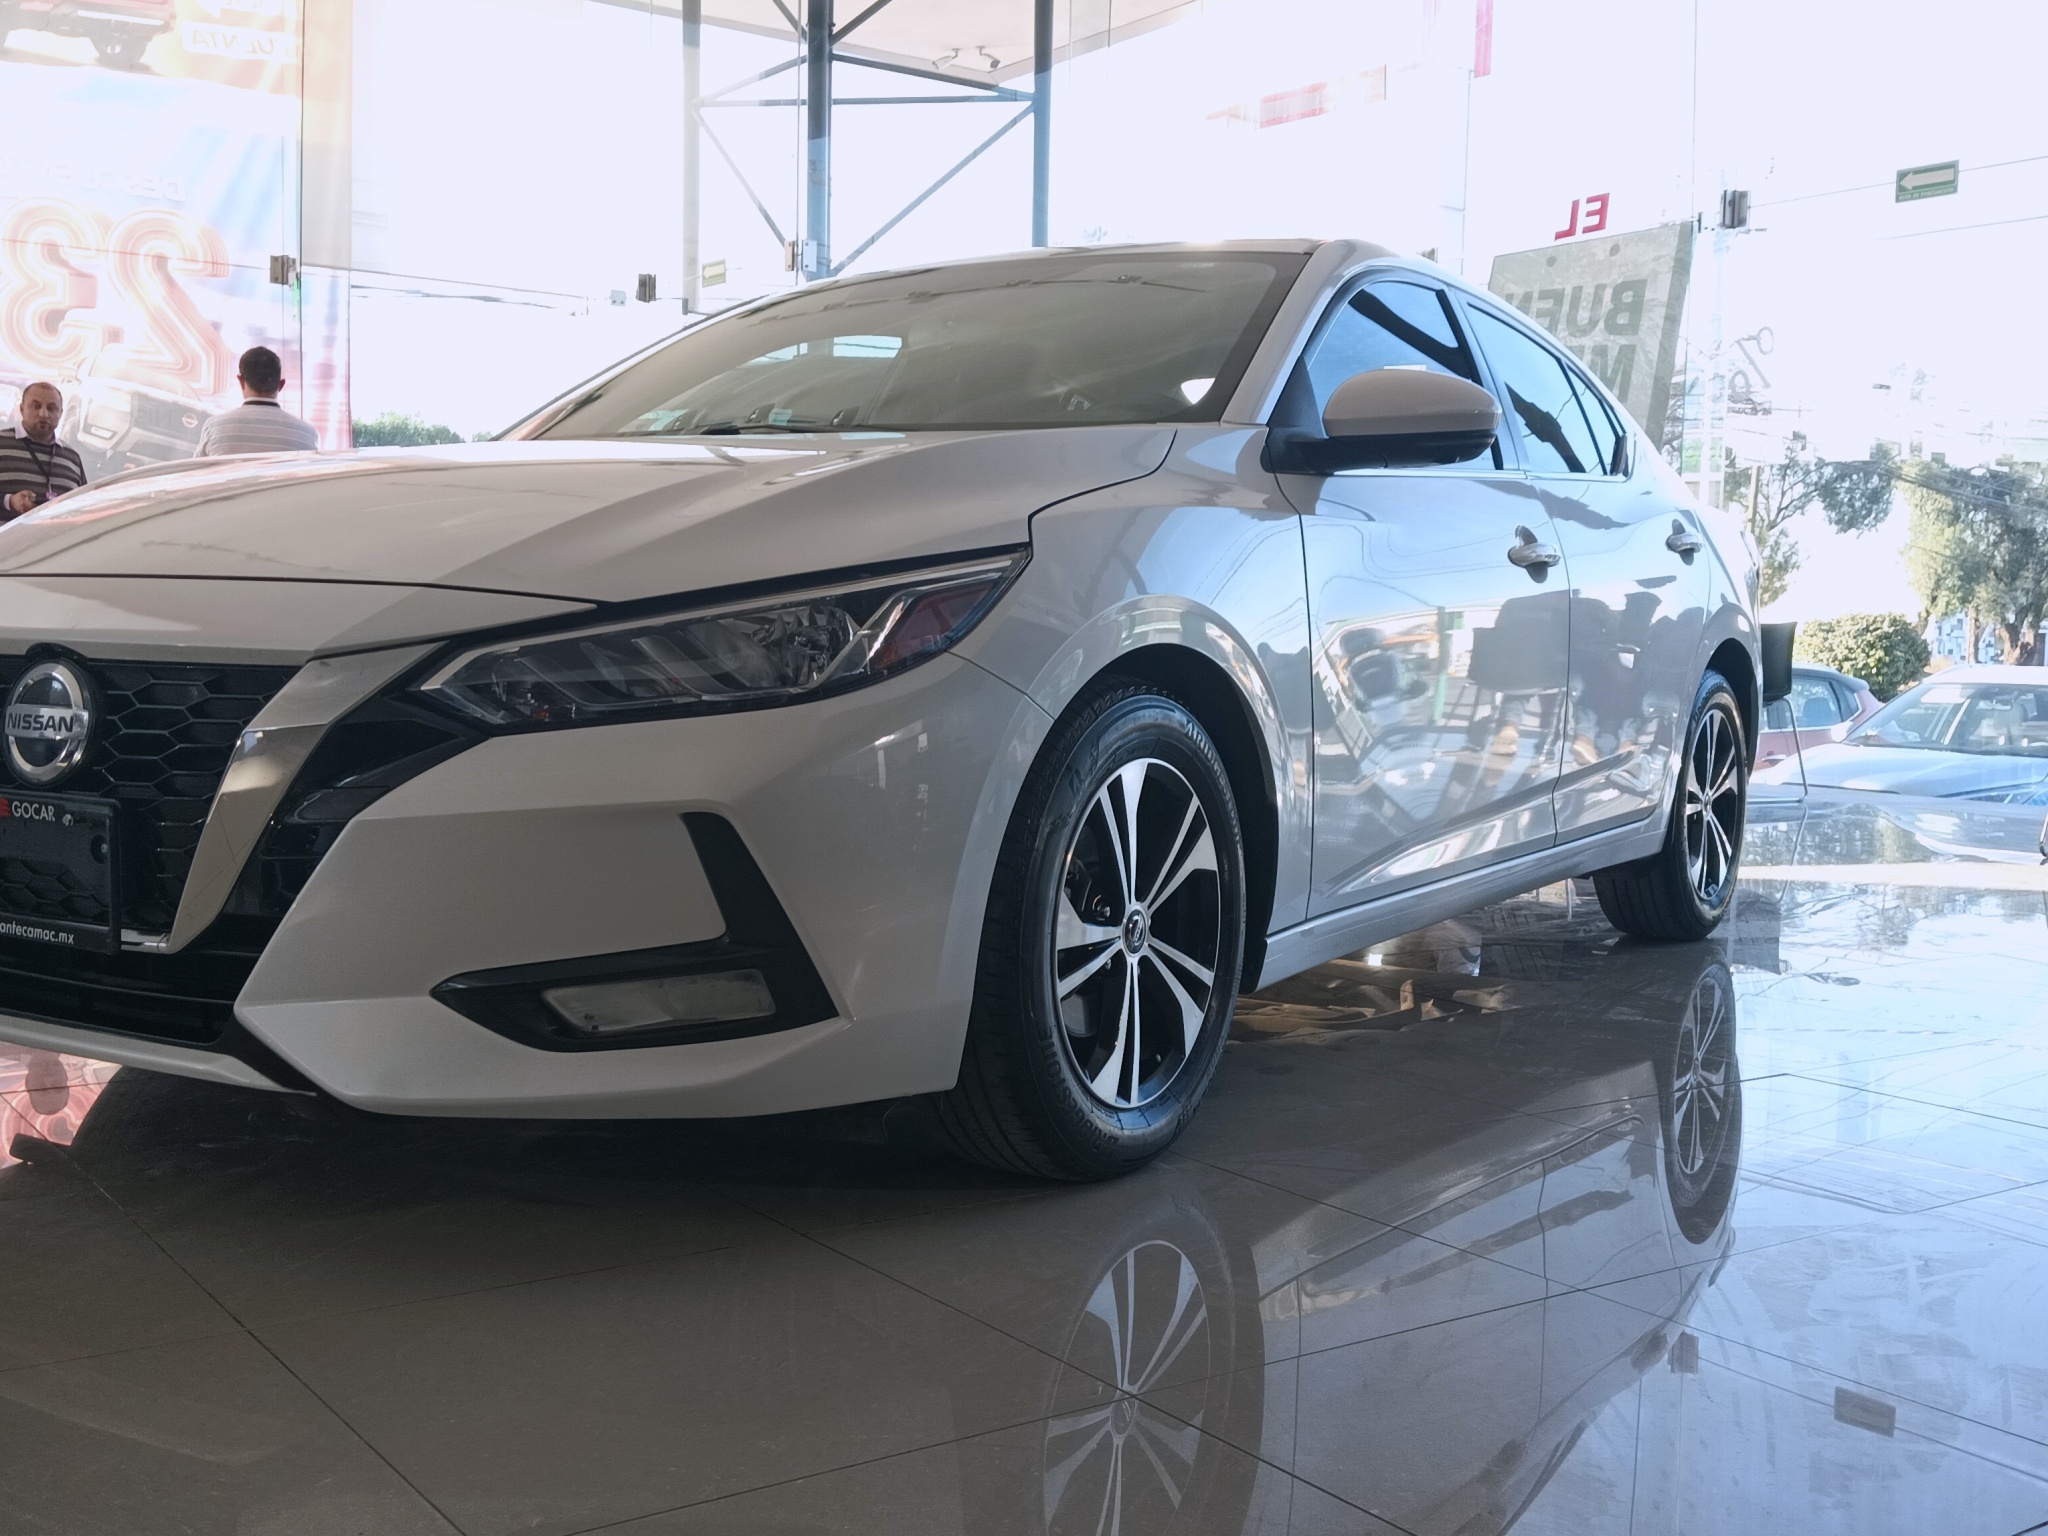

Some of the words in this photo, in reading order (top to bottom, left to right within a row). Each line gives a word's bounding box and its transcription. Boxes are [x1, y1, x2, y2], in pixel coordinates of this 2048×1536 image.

[7, 712, 75, 733] NISSAN
[11, 801, 56, 822] GOCAR
[0, 920, 75, 945] antecamac.mx
